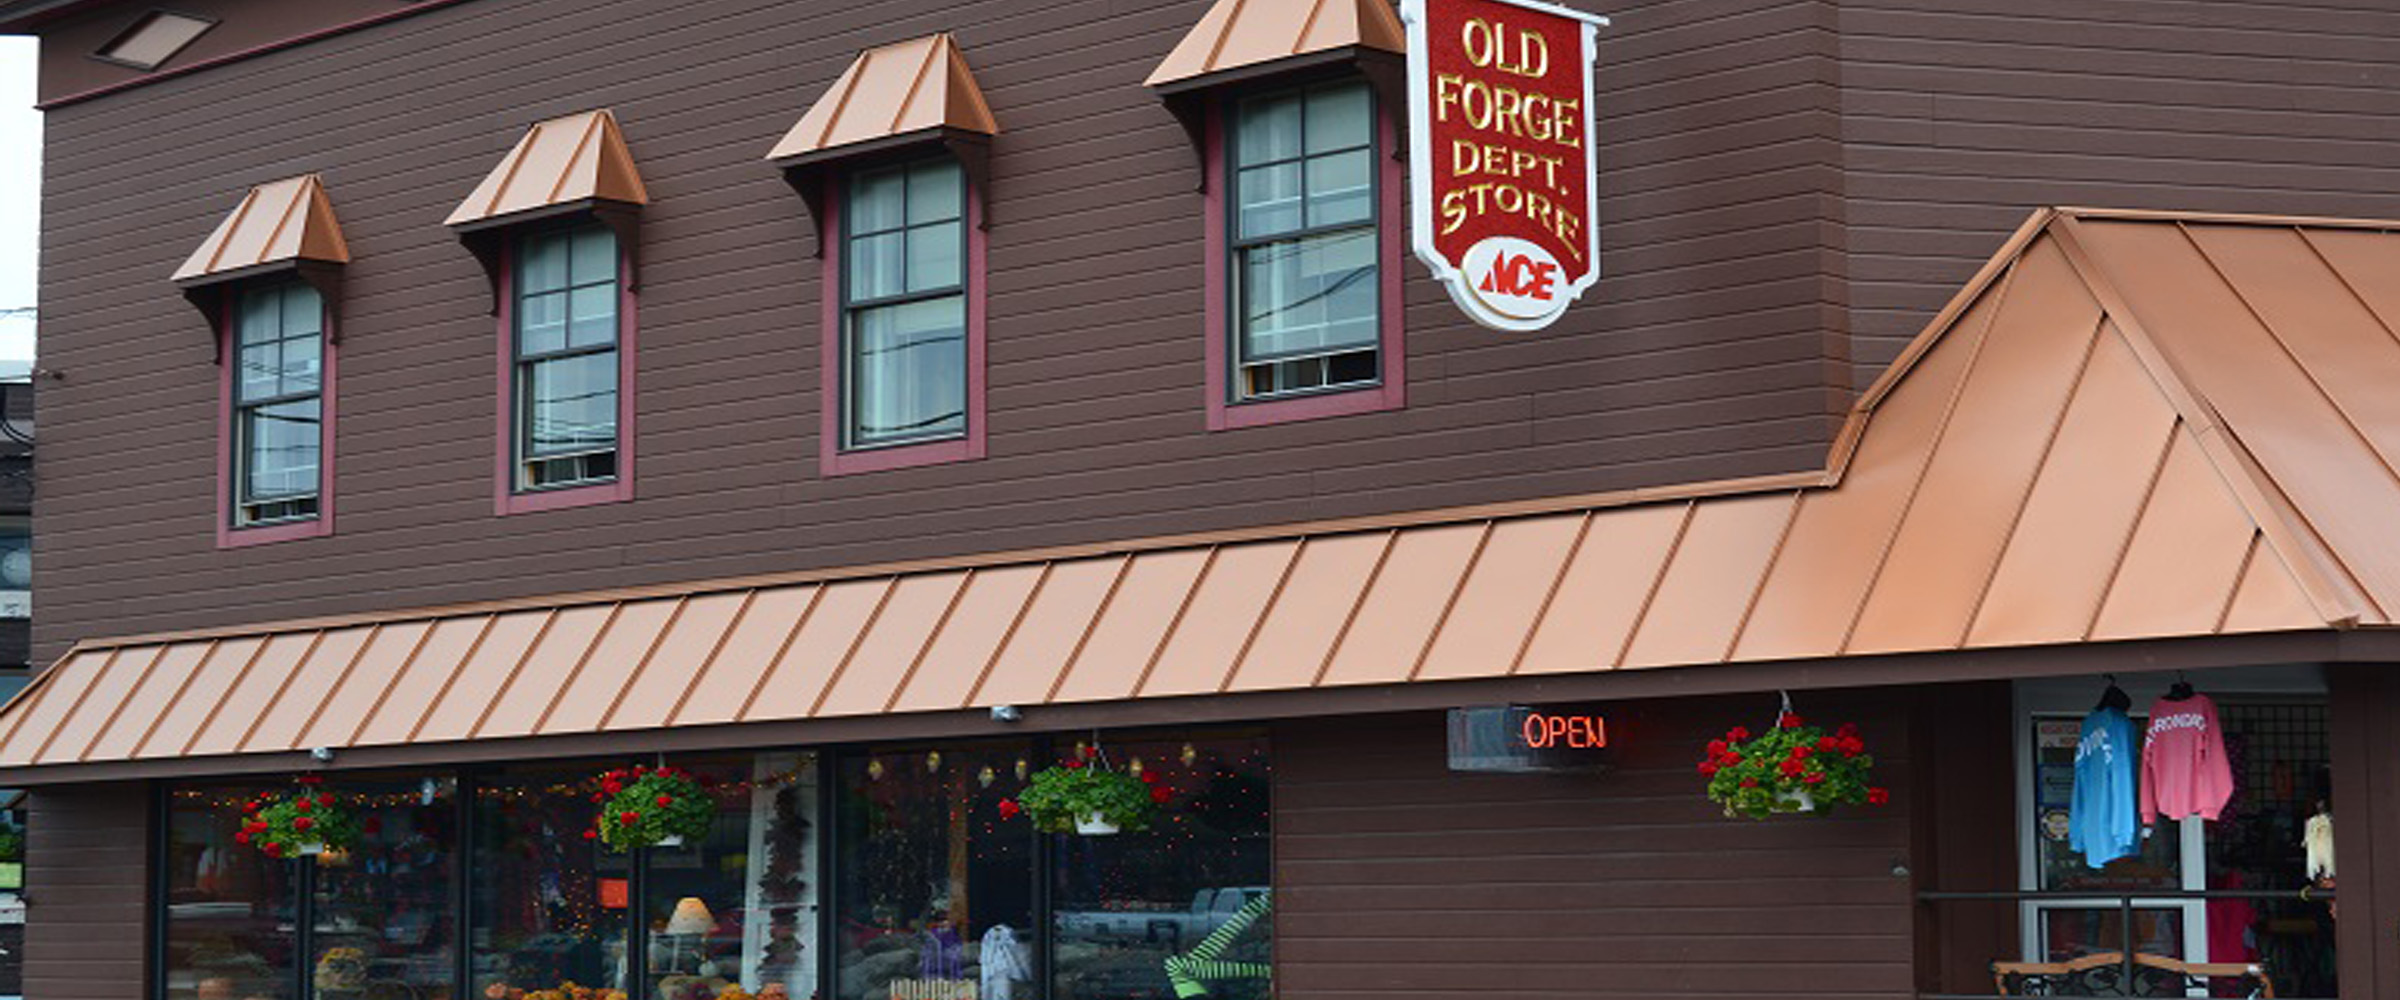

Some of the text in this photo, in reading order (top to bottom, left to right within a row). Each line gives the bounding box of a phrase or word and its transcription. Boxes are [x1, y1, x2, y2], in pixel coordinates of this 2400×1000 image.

[1462, 18, 1548, 77] OLD
[1436, 73, 1580, 149] FORGE
[1452, 139, 1568, 196] DEPT.
[1440, 182, 1582, 262] STORE
[1478, 248, 1557, 301] ACE
[1523, 712, 1607, 748] OPEN
